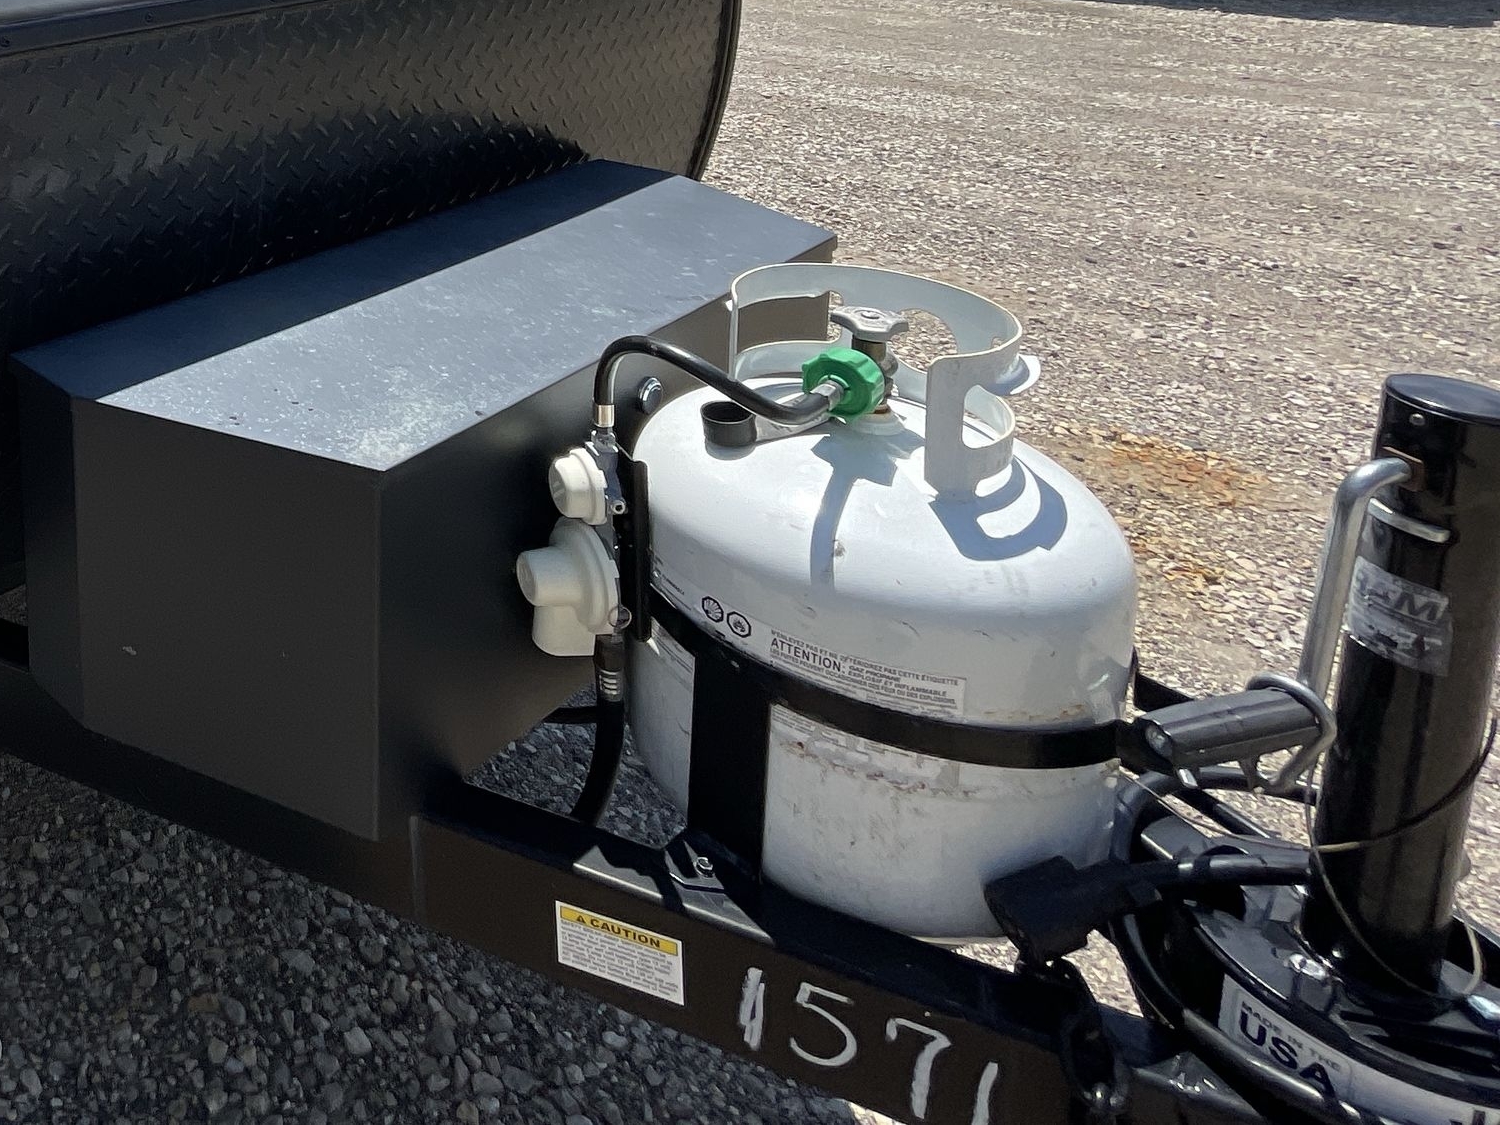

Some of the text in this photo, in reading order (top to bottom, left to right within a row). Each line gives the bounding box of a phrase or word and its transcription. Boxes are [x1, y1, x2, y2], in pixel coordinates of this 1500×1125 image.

[590, 918, 660, 948] CAUTION
[739, 967, 999, 1125] 1571
[1239, 1010, 1336, 1100] USA
